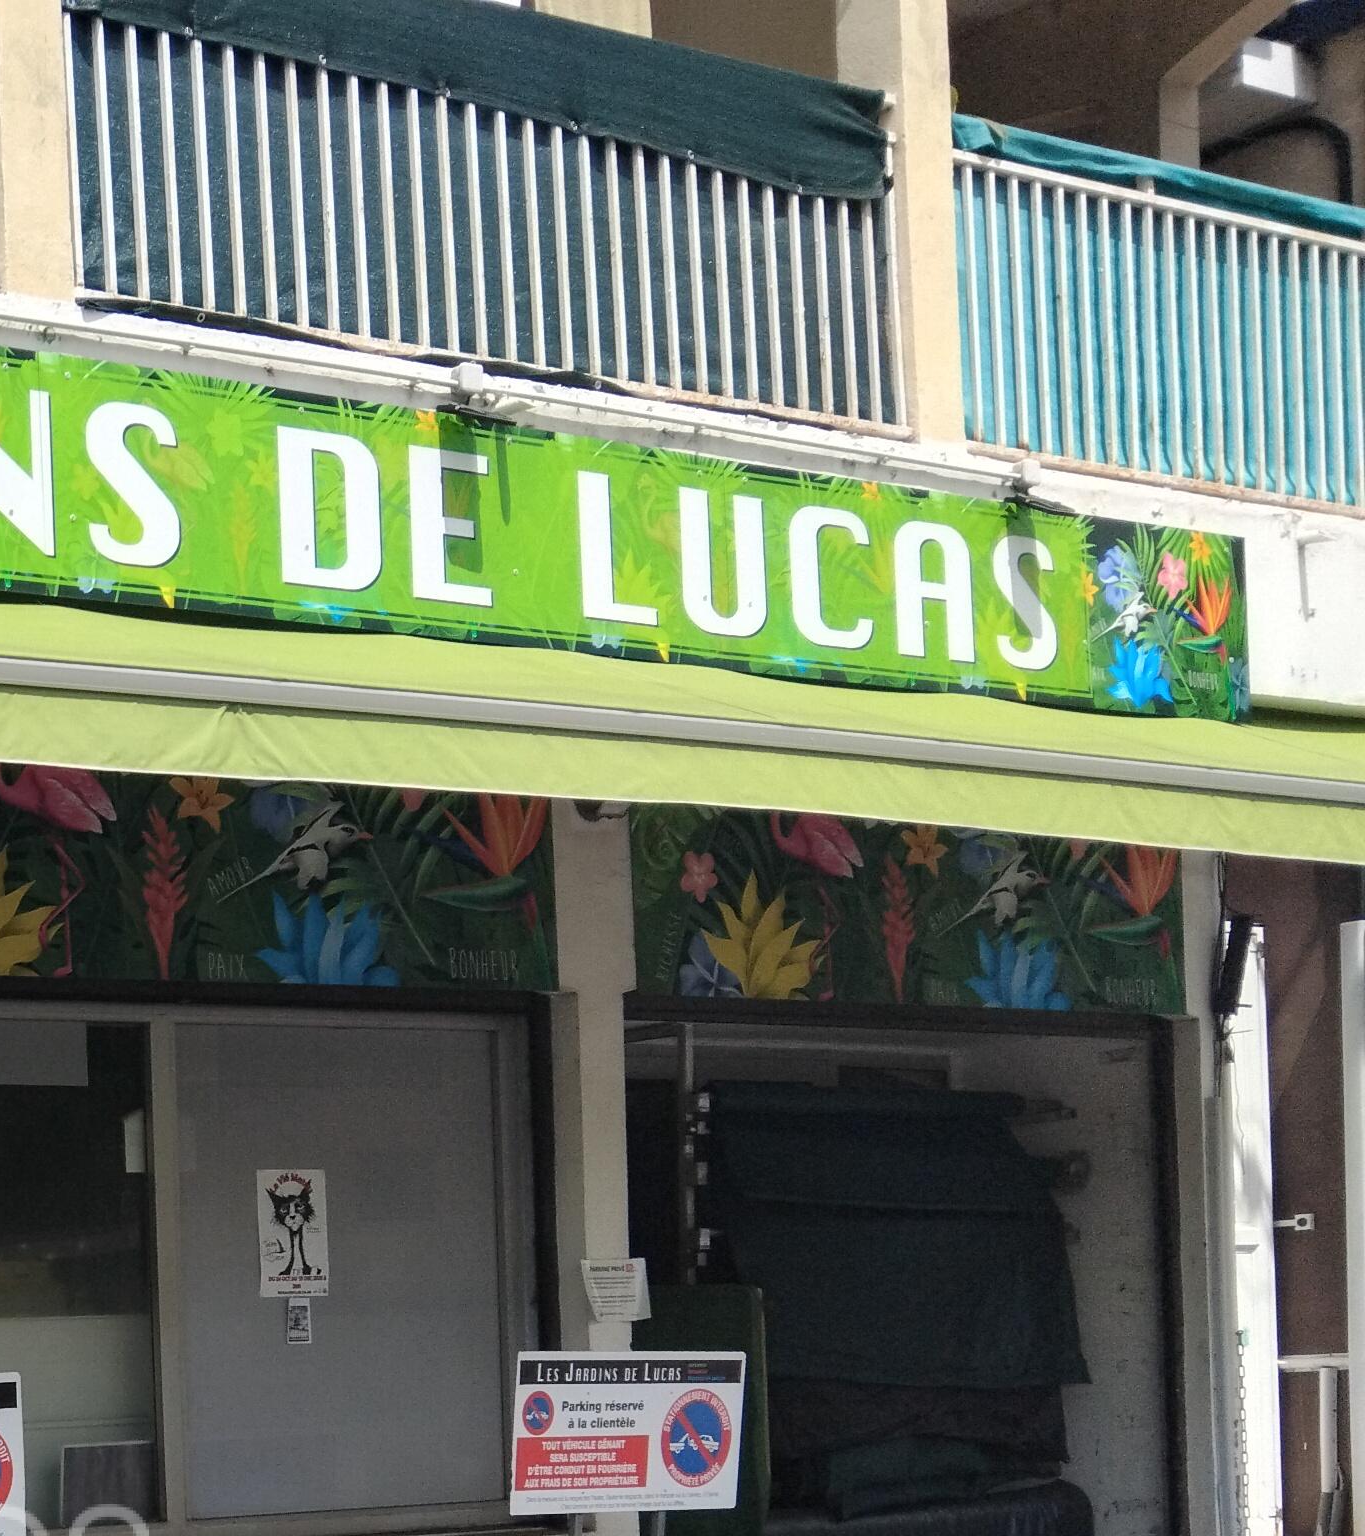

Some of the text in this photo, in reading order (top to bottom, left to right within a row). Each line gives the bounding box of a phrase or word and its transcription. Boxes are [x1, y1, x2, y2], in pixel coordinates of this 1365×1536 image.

[276, 425, 493, 608] DE
[577, 470, 1059, 674] LUCAS
[208, 952, 248, 980] PAIX
[449, 946, 518, 982] BONHEUR
[537, 1363, 559, 1382] LES
[565, 1362, 617, 1382] JARDINS
[624, 1367, 638, 1382] DE
[644, 1362, 682, 1381] LUCAS
[561, 1400, 644, 1413] Parking réservé
[568, 1417, 635, 1428] à la clientèle
[542, 1441, 561, 1451] TOUT
[570, 1452, 616, 1463] SUSCEPTIBLE
[554, 1465, 586, 1475] CONDUIT
[524, 1479, 539, 1488] AUX
[540, 1478, 561, 1488] FRAIS
[562, 1477, 572, 1487] DE
